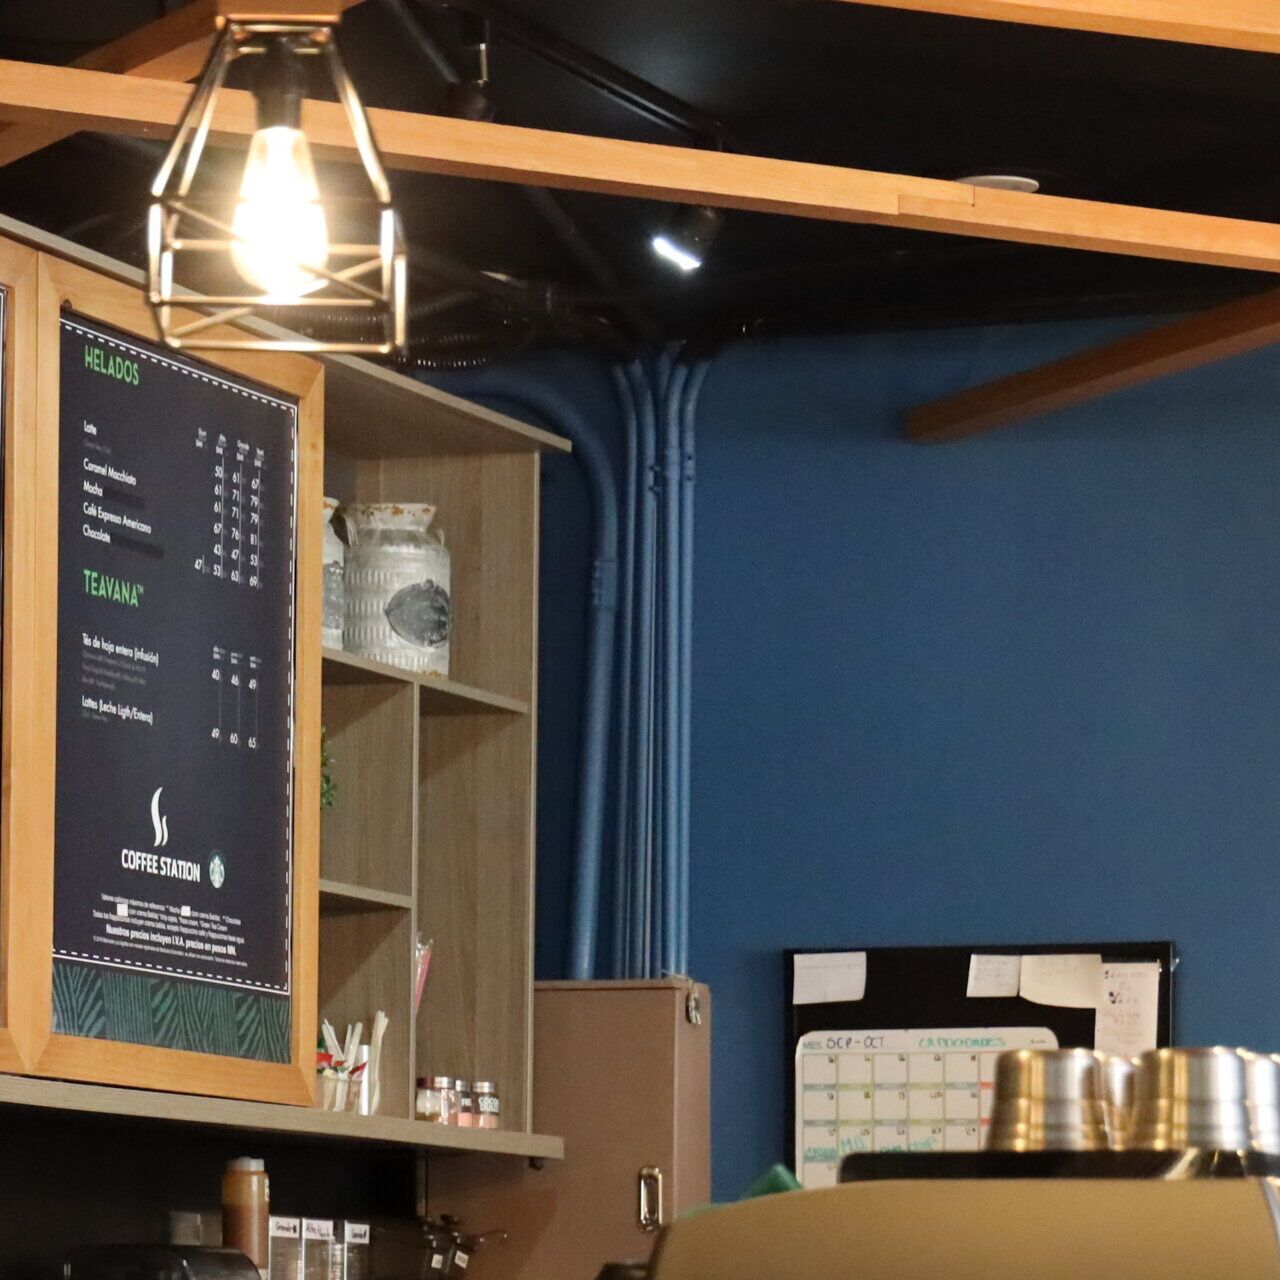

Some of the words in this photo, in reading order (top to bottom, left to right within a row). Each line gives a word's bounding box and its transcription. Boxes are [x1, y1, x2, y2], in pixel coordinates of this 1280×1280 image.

[84, 345, 140, 386] HELADOS
[83, 420, 97, 435] Latte
[83, 458, 108, 477] Caramel
[108, 465, 137, 486] Macchiato
[83, 480, 103, 497] Mocha
[83, 502, 97, 516] Café
[122, 515, 152, 535] Americano
[82, 523, 111, 543] Chocolate
[92, 635, 101, 648] de
[101, 637, 114, 655] hoja
[134, 646, 159, 667] (infusión)
[211, 668, 220, 680] 40
[230, 674, 240, 686] 46
[248, 679, 257, 690] 49
[81, 694, 98, 710] Lattes
[98, 698, 117, 715] (Leche
[211, 728, 219, 740] 49
[229, 732, 238, 745] 60
[248, 737, 256, 749] 65
[121, 849, 158, 875] COFFEE
[159, 857, 201, 883] STATION
[106, 923, 130, 937] Nuestros
[130, 929, 150, 940] precios
[150, 931, 171, 946] incluyen
[185, 939, 204, 950] precios
[204, 942, 212, 951] en
[212, 943, 227, 954] pesos
[803, 1041, 822, 1050] MES
